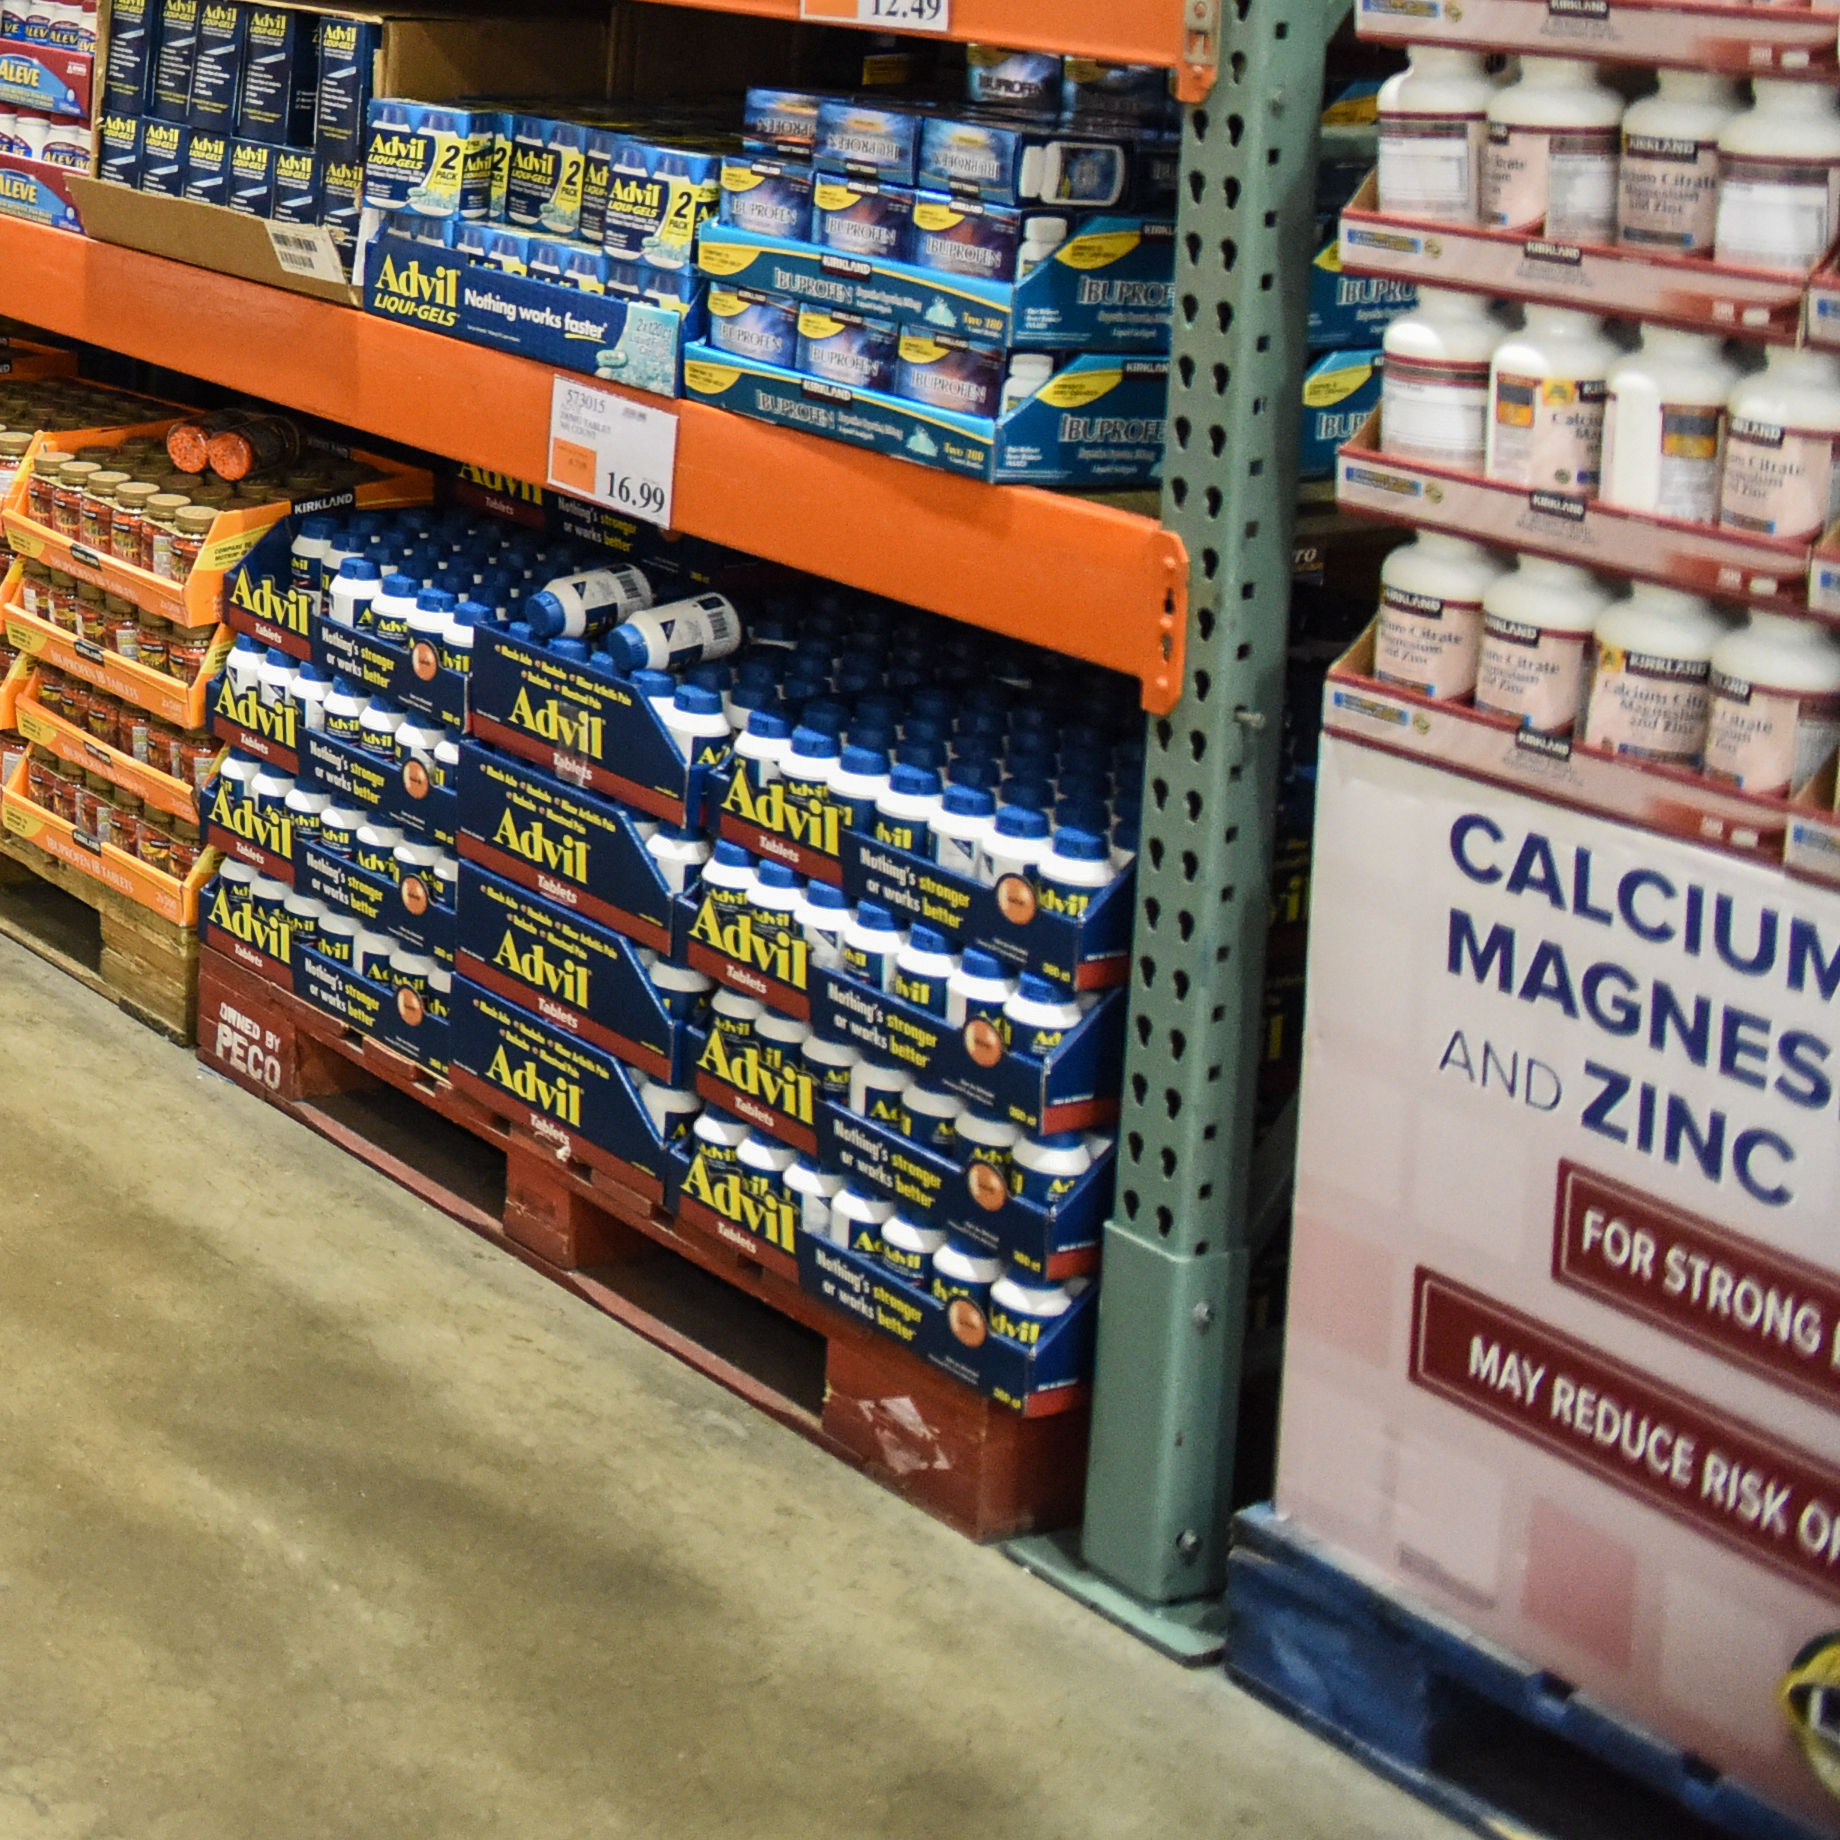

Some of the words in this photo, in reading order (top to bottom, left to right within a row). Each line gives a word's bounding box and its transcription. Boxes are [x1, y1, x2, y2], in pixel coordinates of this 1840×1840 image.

[367, 153, 424, 170] LIQUI-GELS
[369, 133, 427, 160] Advil
[440, 144, 460, 171] 2
[436, 170, 458, 182] PACK
[731, 198, 797, 225] IBUPROFEN
[821, 255, 872, 276] KIRKLAND
[1526, 241, 1581, 259] KIRKLAND
[375, 254, 461, 309] Advil
[774, 267, 854, 304] IBUPROFEN
[373, 292, 460, 327] LIQUI-GELS
[464, 288, 517, 323] Nothing
[519, 306, 562, 329] works
[564, 312, 608, 339] faster
[567, 389, 605, 414] 573015
[293, 494, 354, 514] KIRKLAND
[606, 471, 665, 514] 16.99
[1532, 494, 1584, 515] KIRKLAND
[229, 567, 312, 637] Advil
[255, 622, 283, 644] Tablets
[321, 626, 359, 657] Nothing's
[360, 641, 395, 671] stronger
[326, 653, 336, 665] or
[337, 655, 362, 677] works
[363, 663, 391, 689] better
[508, 686, 606, 760] Advil
[552, 752, 592, 780] Tablets
[721, 767, 842, 857] Advil
[759, 835, 800, 865] Tablets
[1450, 812, 1840, 1002] CALCIUM
[219, 1001, 261, 1040] OWNED
[265, 1029, 281, 1052] BY
[1447, 907, 1840, 1111] MAGNES
[216, 1023, 281, 1090] PECO
[1438, 1029, 1563, 1112] AND
[1580, 1059, 1796, 1207] ZINC
[1581, 1209, 1657, 1282] FOR
[1662, 1245, 1822, 1358] STRONG
[1468, 1335, 1546, 1406] MAY
[1551, 1375, 1698, 1489] REDUCE
[1700, 1450, 1793, 1535] RISK
